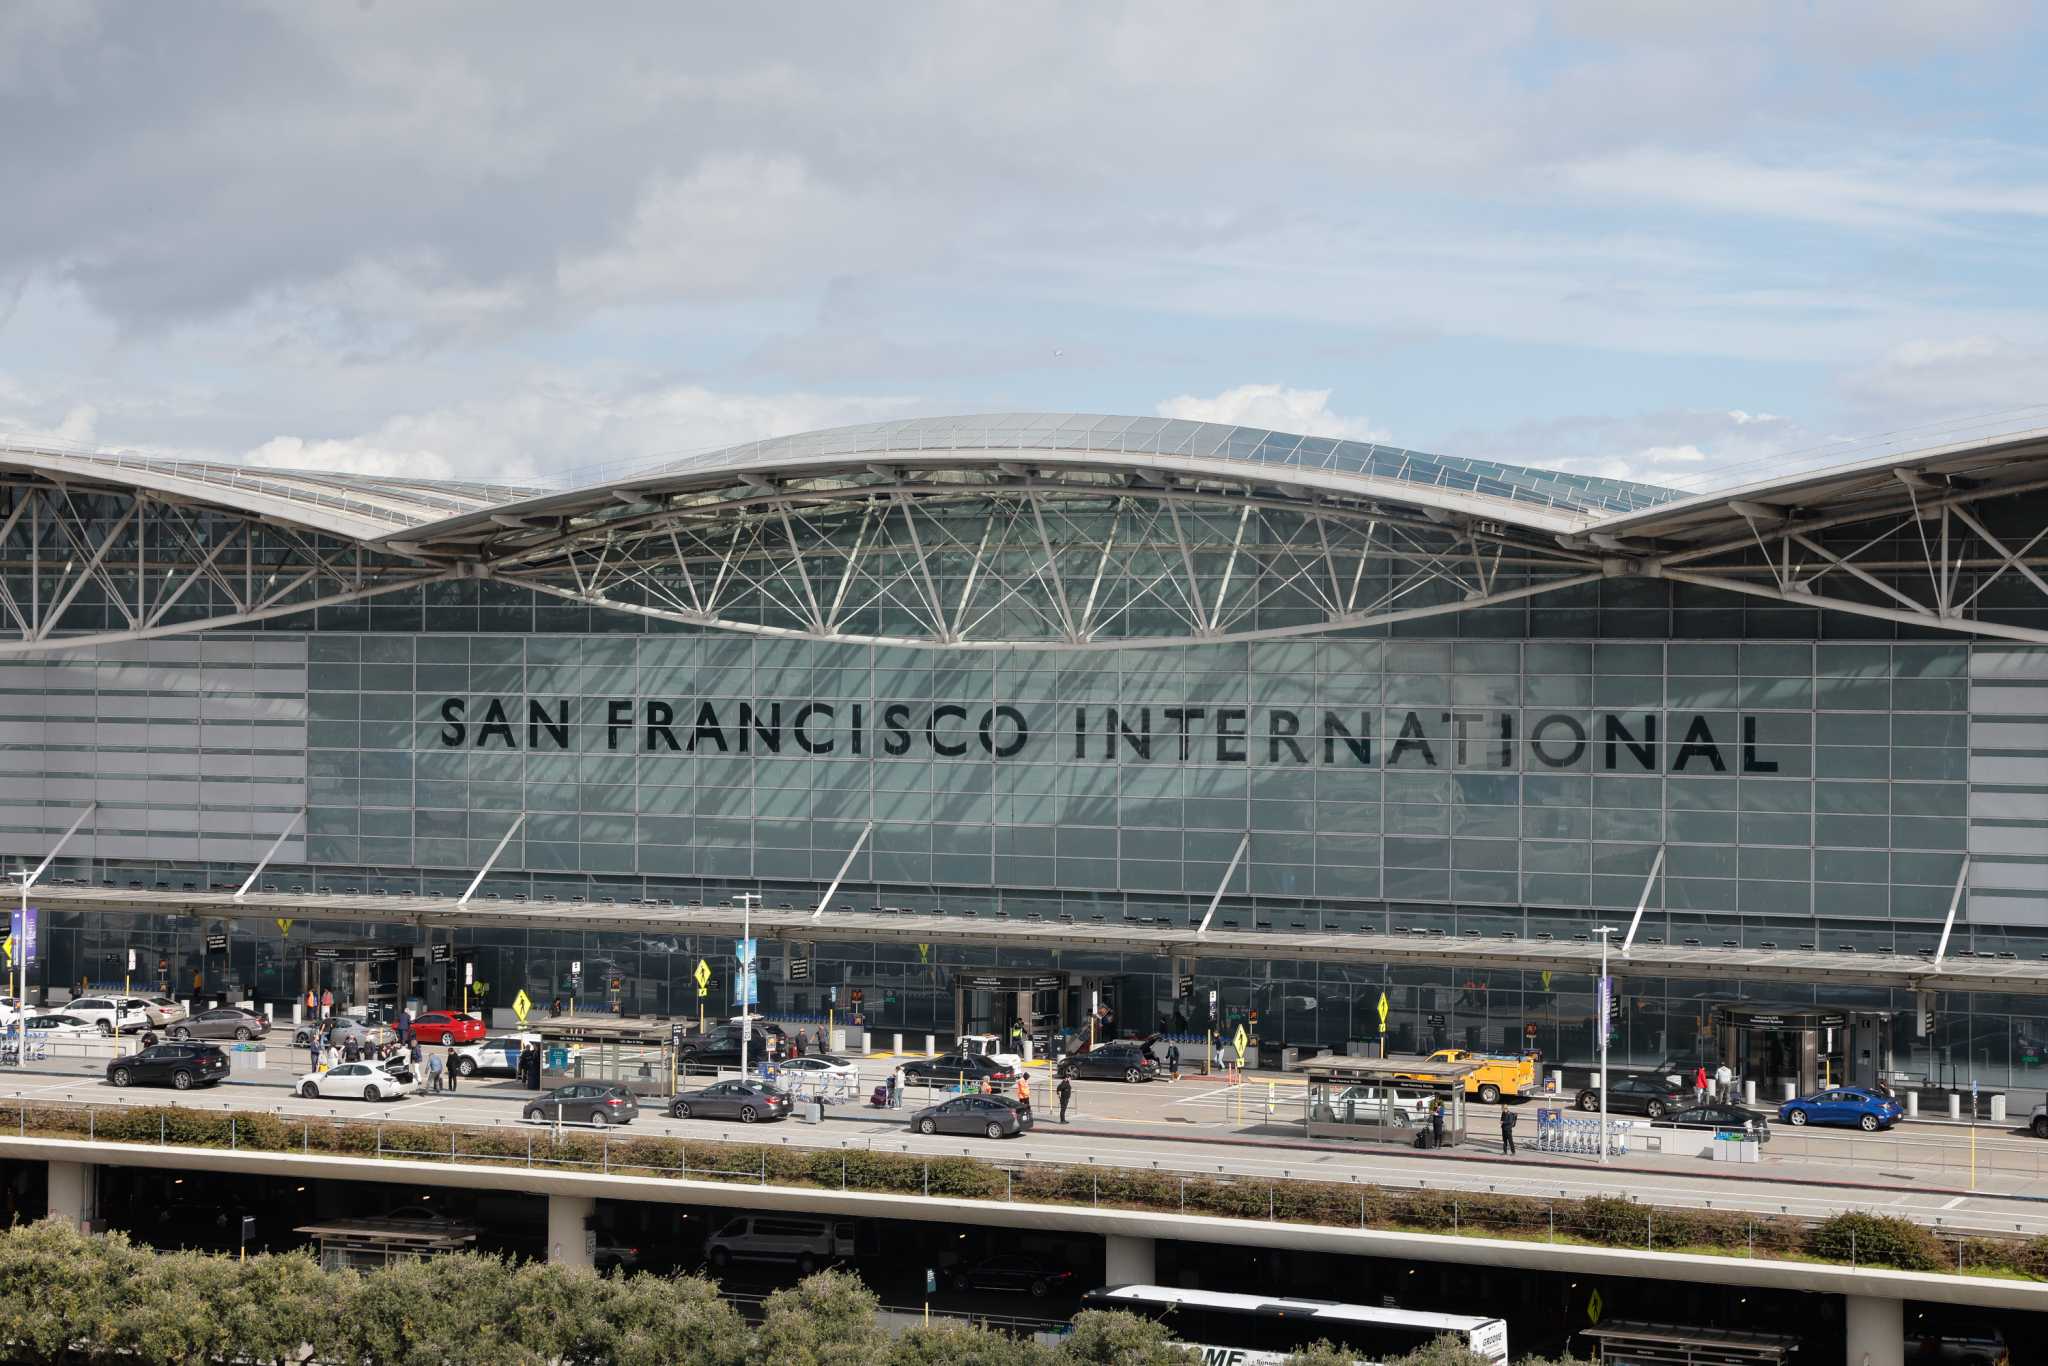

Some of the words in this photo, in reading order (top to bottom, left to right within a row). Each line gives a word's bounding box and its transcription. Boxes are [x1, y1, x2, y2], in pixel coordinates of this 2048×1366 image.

[441, 698, 569, 749] SAN
[608, 700, 1028, 757] FRANCISCO
[1075, 707, 1778, 772] INTERNATIONAL
